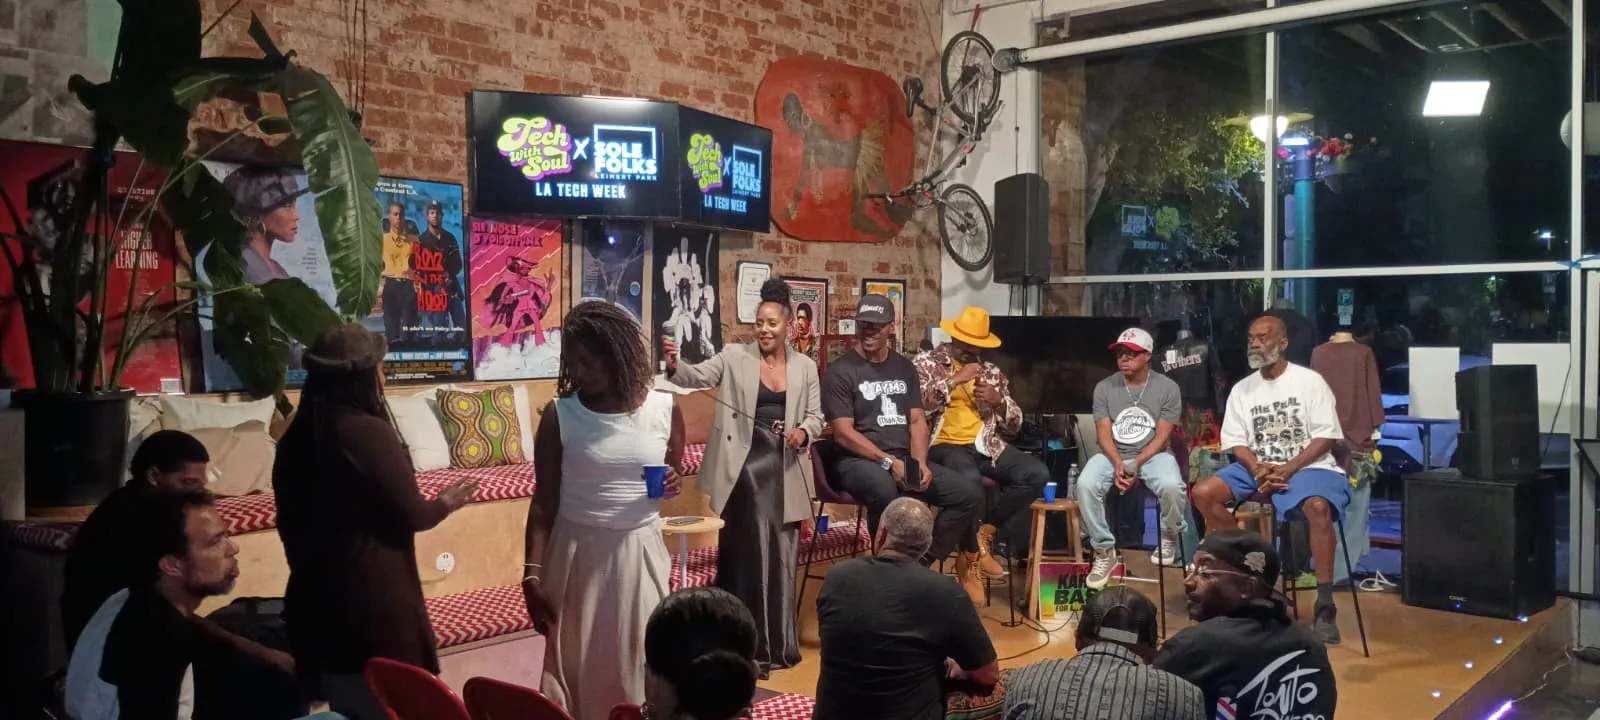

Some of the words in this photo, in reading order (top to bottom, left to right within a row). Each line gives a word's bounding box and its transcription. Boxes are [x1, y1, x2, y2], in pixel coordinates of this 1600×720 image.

[497, 117, 569, 152] Tech
[510, 146, 542, 163] with
[594, 142, 643, 159] SOLE
[687, 133, 722, 165] Tech
[522, 147, 569, 177] Soul
[594, 158, 657, 175] FOLKS
[693, 161, 710, 177] with
[732, 160, 756, 178] SOLE
[699, 161, 722, 189] Soul
[732, 174, 762, 193] FOLKS
[536, 182, 552, 196] LA
[557, 183, 588, 197] TECH
[592, 184, 626, 199] WEEK
[704, 195, 713, 208] LA
[714, 196, 730, 211] TECH
[731, 198, 747, 213] WEEK
[115, 250, 158, 270] LEARNING
[413, 241, 445, 271] BOYZ
[417, 287, 449, 312] HOOD
[1250, 405, 1271, 416] THE
